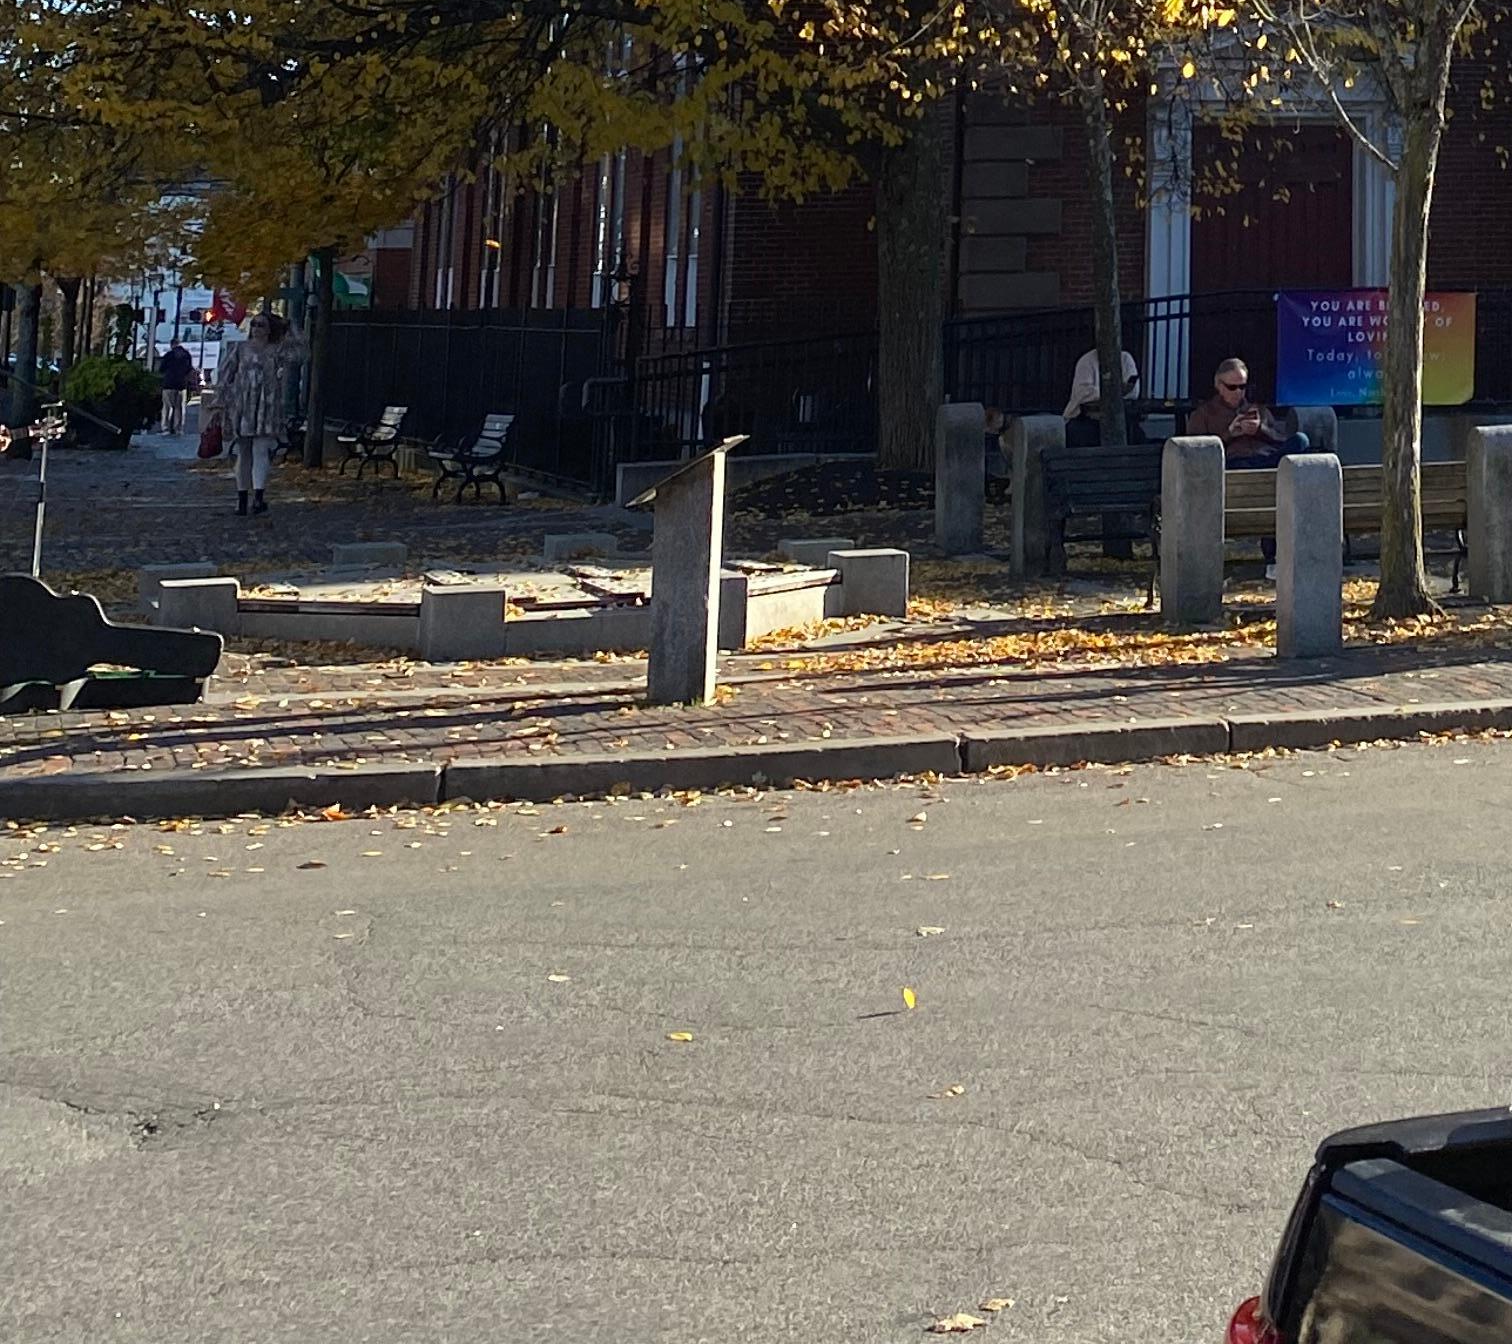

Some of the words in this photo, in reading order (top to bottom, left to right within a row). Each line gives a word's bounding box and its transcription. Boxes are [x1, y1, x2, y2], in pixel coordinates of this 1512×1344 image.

[1310, 300, 1340, 312] YOU
[1346, 300, 1371, 312] ARE
[1302, 316, 1332, 327] YOU
[1338, 316, 1363, 327] ARE
[1435, 316, 1452, 328] OF
[1306, 348, 1359, 364] Today,
